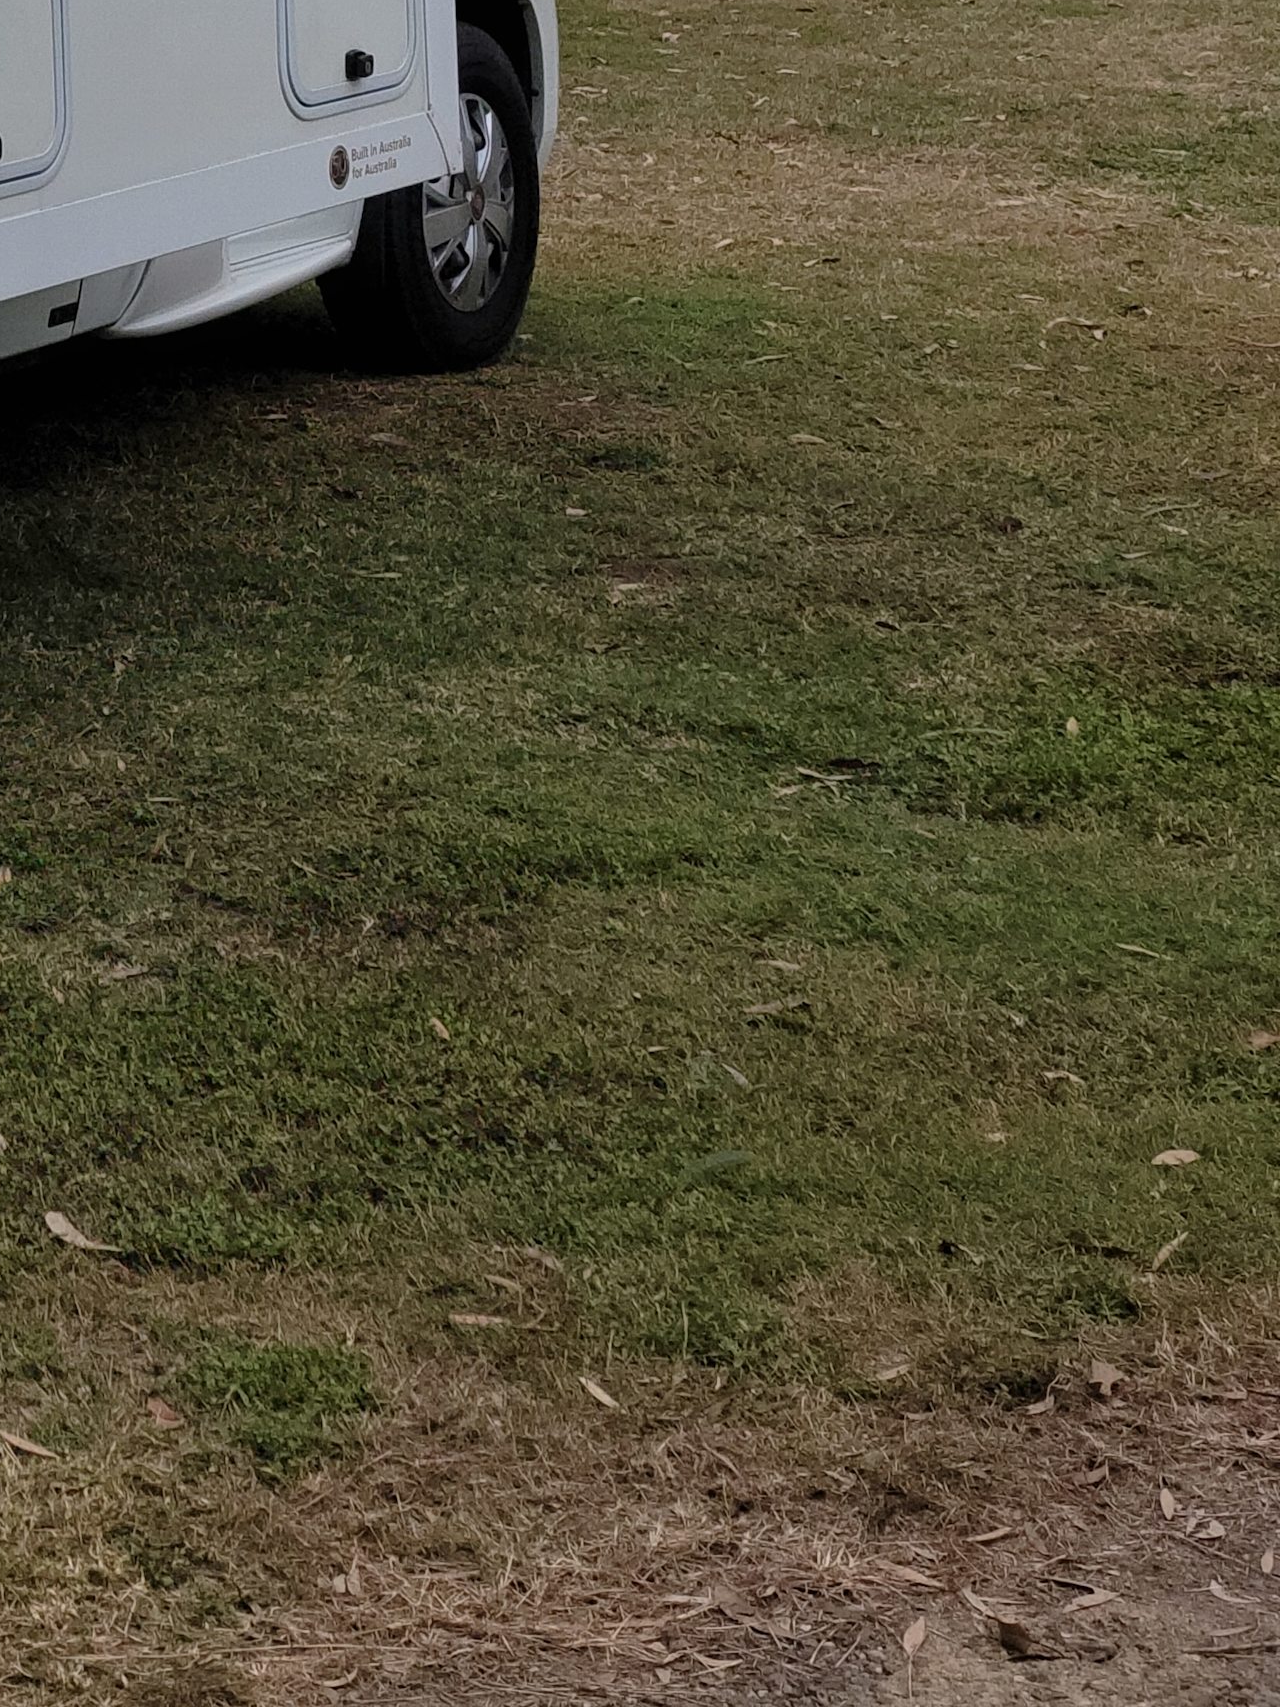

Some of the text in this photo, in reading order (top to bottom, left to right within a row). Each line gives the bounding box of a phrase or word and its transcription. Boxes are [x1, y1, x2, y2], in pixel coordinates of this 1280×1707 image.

[351, 146, 369, 162] Built
[379, 136, 411, 154] Australia
[352, 157, 397, 179] for Australia
